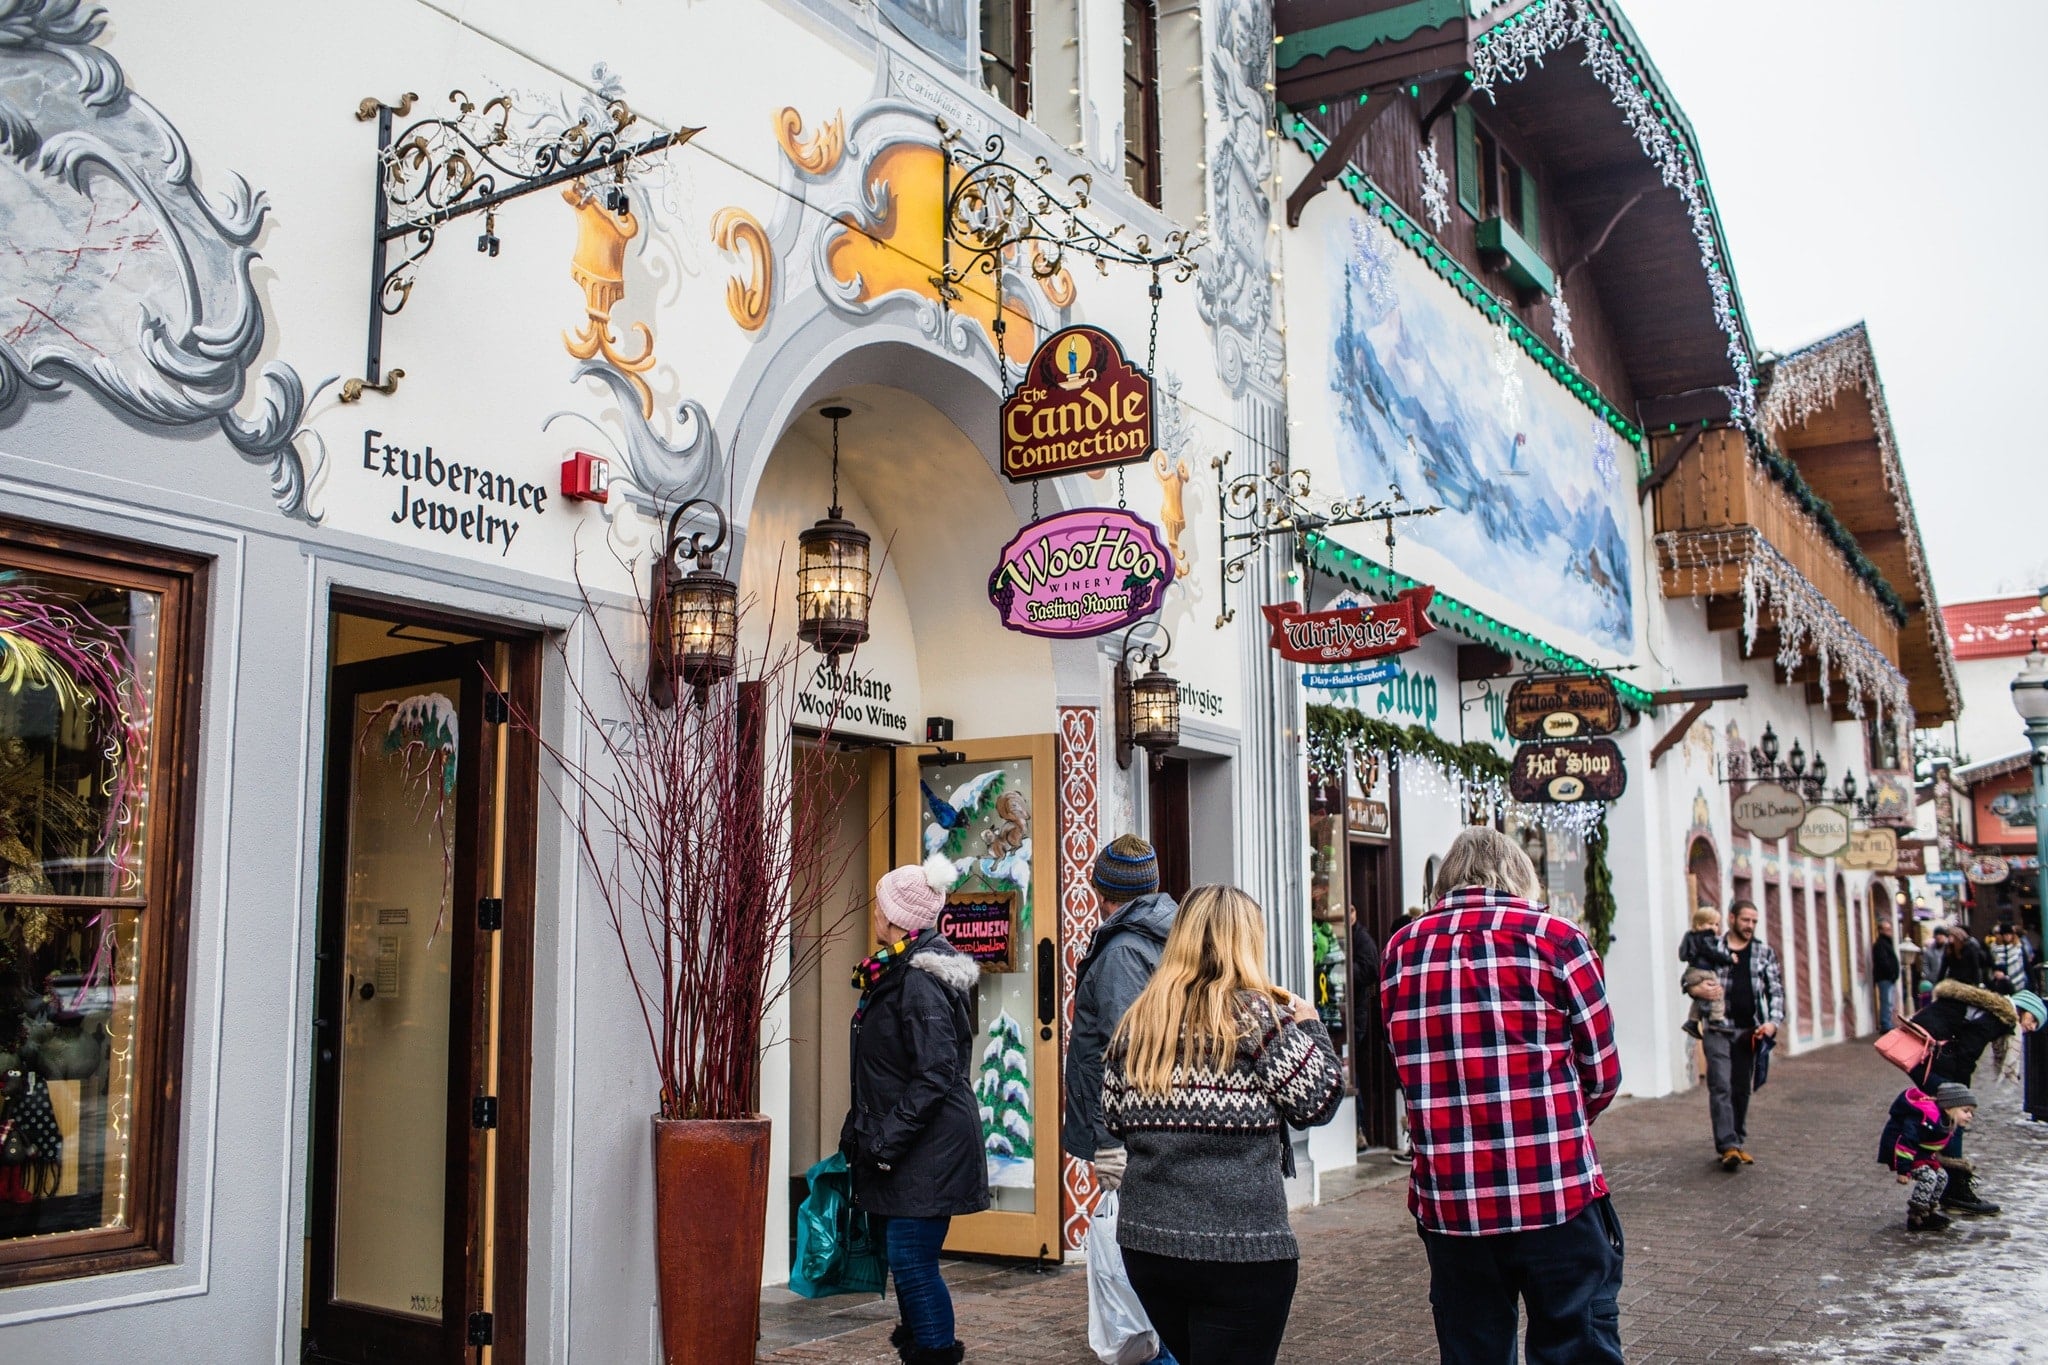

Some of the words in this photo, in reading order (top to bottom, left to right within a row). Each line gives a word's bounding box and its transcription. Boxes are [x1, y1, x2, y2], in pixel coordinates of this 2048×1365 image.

[897, 70, 905, 81] 2
[906, 72, 962, 119] Corinthians
[1007, 381, 1146, 443] Candle
[1021, 387, 1048, 403] The
[1007, 428, 1147, 469] Connection
[363, 429, 548, 514] Exuberance
[391, 485, 519, 557] Jewelry
[995, 526, 1158, 595] WooHoo
[1049, 576, 1112, 593] WINERY
[1026, 599, 1080, 622] Tasting
[1082, 592, 1129, 615] Room
[1283, 617, 1406, 658] Würlygigz
[798, 692, 862, 721] WooHoo
[865, 704, 907, 731] Wines
[1520, 693, 1563, 712] Wood
[1568, 691, 1607, 709] Shop
[1526, 753, 1557, 779] Hat
[1566, 752, 1611, 776] Shop
[1800, 823, 1844, 834] PAPRIKA
[941, 913, 1009, 938] GLUHWEIN
